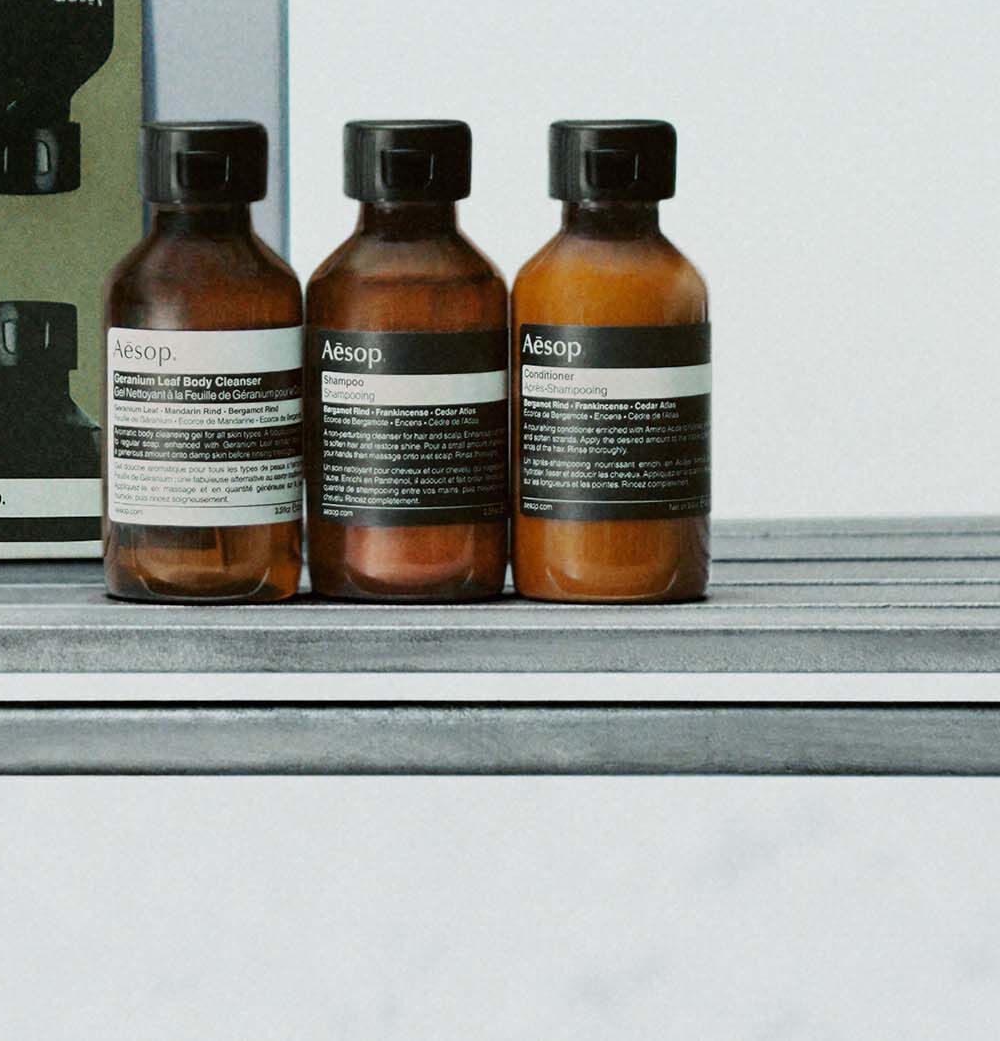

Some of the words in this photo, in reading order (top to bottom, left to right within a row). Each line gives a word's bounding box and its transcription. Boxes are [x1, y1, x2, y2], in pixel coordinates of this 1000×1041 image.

[113, 338, 176, 366] Aēsop.
[113, 373, 155, 386] Geranium
[157, 376, 181, 386] Leaf
[183, 376, 212, 389] Body
[215, 376, 262, 387] Cleanser
[323, 374, 364, 388] Shampoo
[524, 368, 575, 381] Conditioner
[113, 386, 126, 397] Gel
[126, 387, 165, 401] Nettoyant
[167, 389, 173, 399] à
[174, 390, 183, 399] la
[185, 390, 216, 400] Feuille
[218, 390, 231, 400] de
[232, 389, 274, 400] Géranium
[323, 388, 376, 402] Shampooing
[164, 407, 200, 415] Mandarin
[228, 407, 263, 415] Bergamot
[323, 404, 352, 415] Bergamot
[353, 407, 369, 415] Rind
[375, 407, 429, 417] Frankincense
[434, 407, 457, 416] Cedar
[552, 401, 569, 410] Rind
[575, 401, 628, 410] Frankincense
[634, 401, 658, 410] Cedar
[394, 418, 422, 426] Encens
